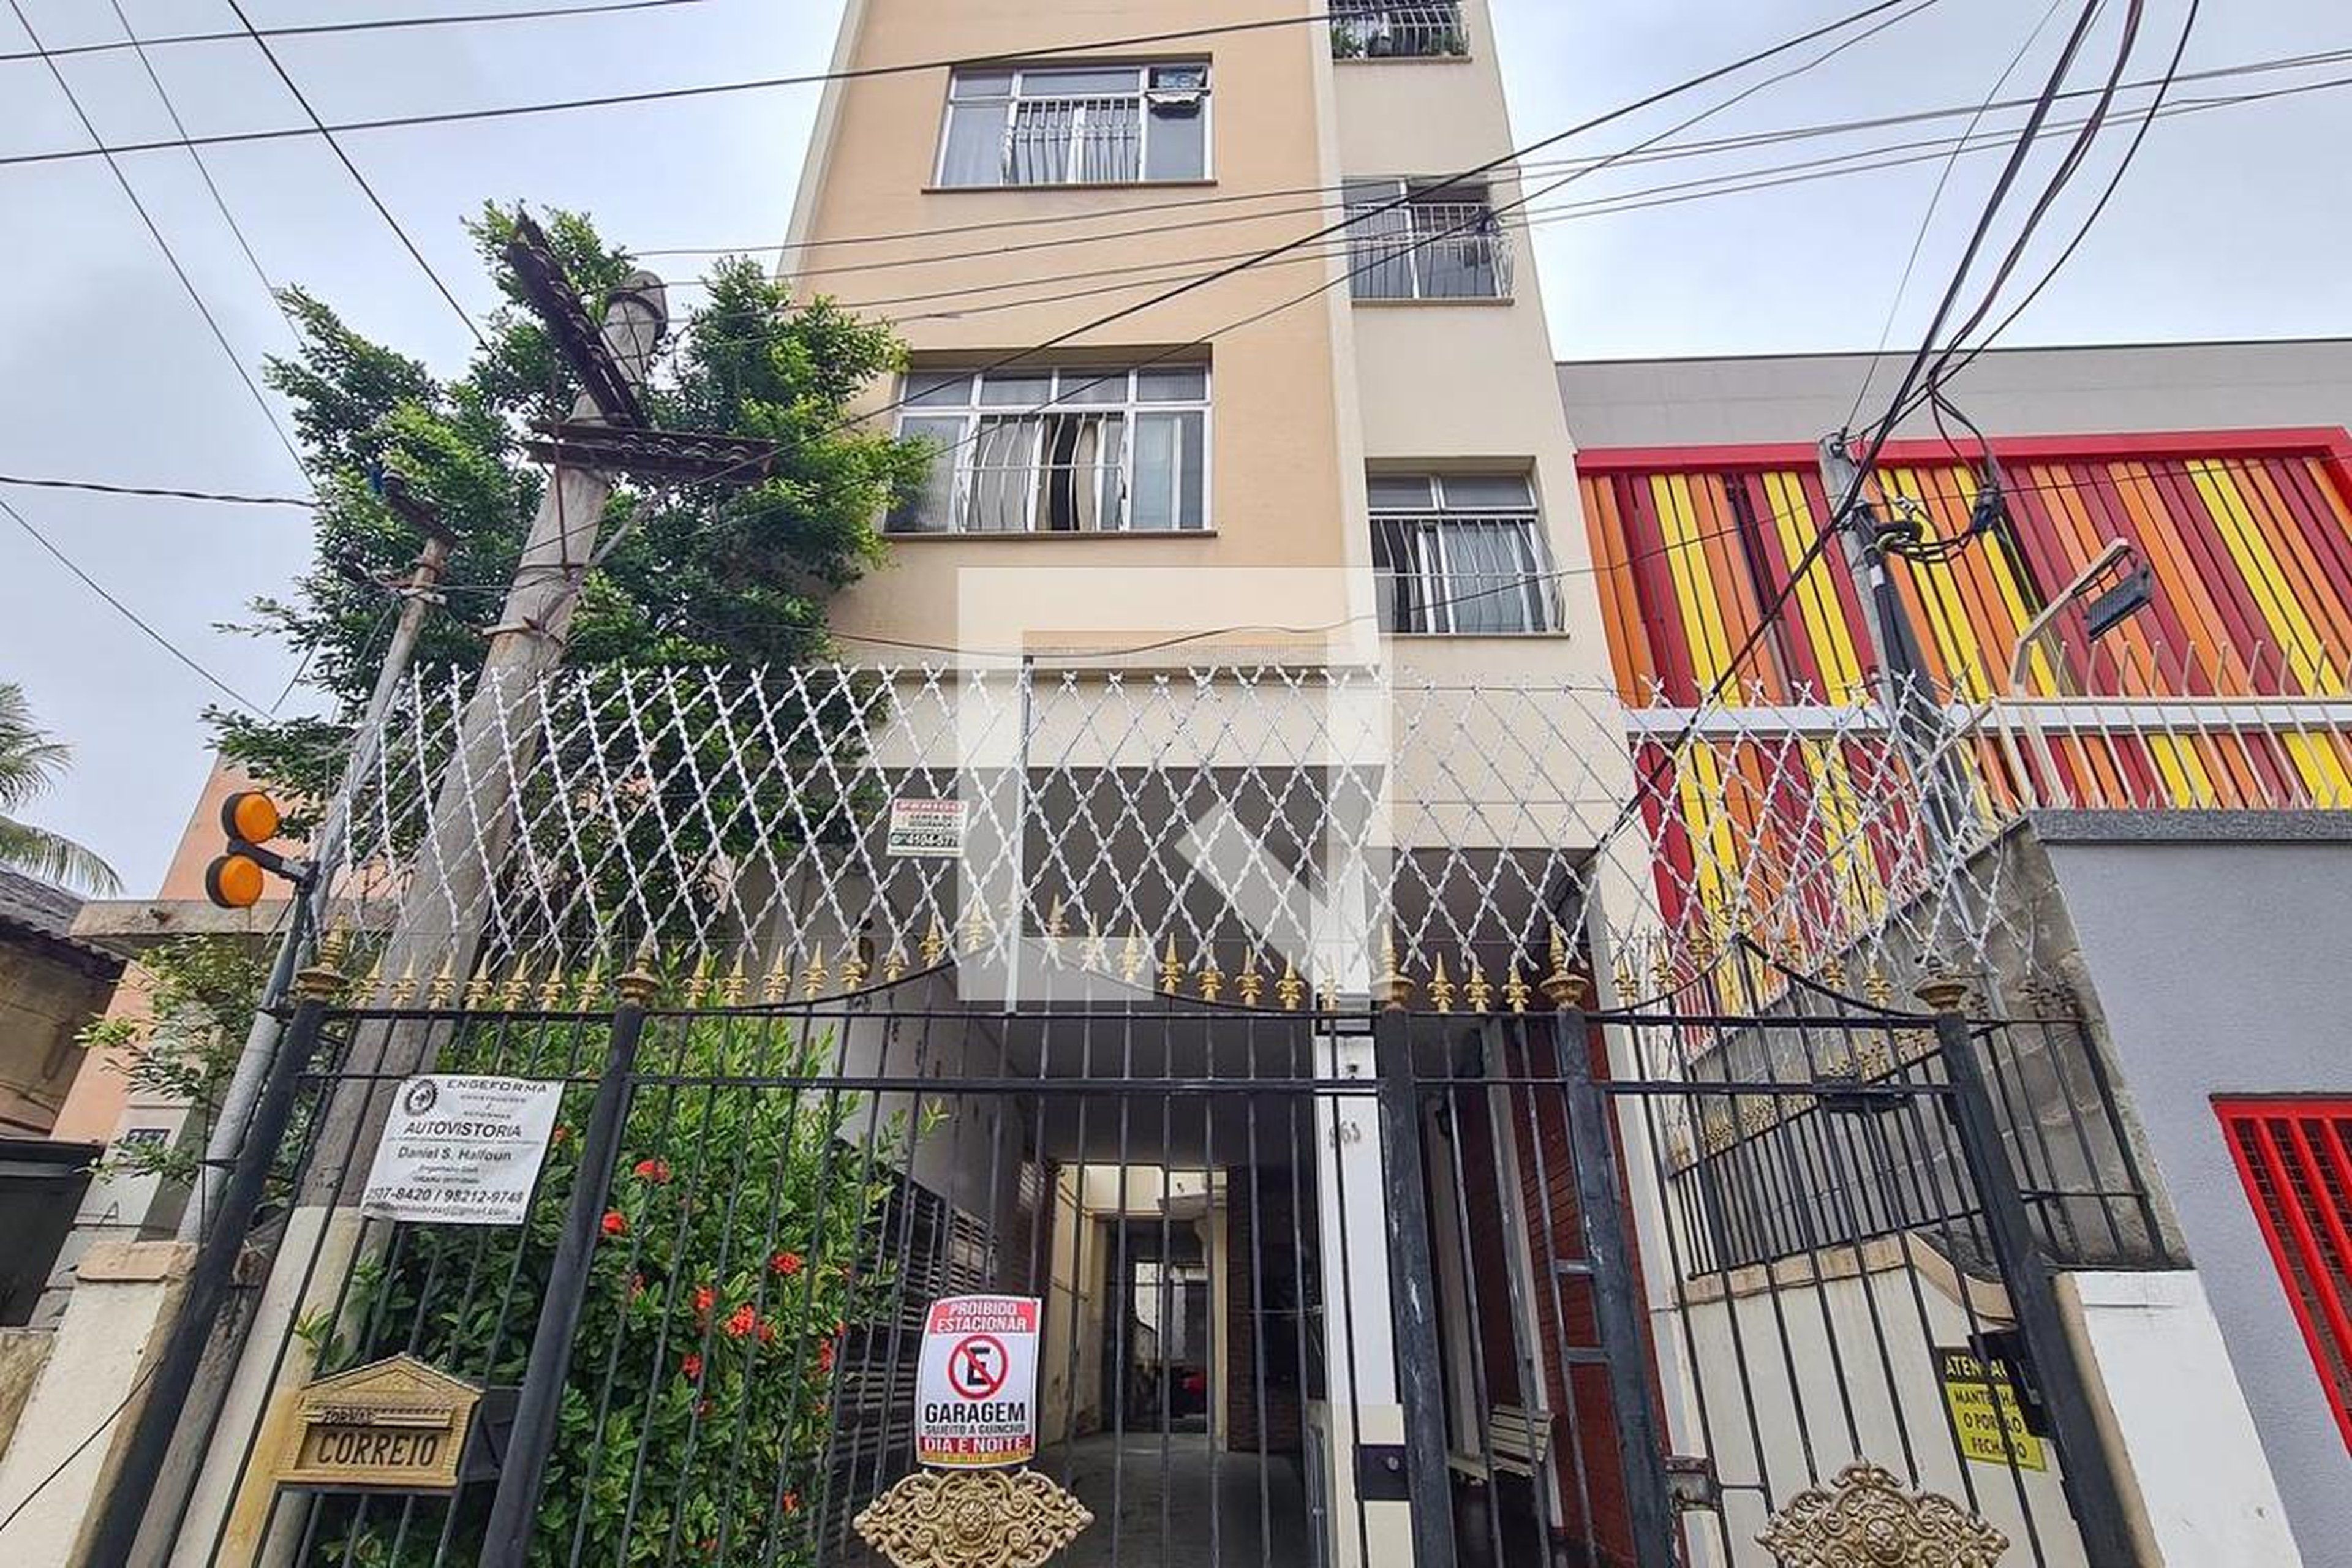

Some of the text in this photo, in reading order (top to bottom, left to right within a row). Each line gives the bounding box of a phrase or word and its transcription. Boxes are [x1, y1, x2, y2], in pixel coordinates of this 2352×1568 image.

[446, 1079, 548, 1094] ENGEFORMA
[404, 1121, 522, 1138] AUTOVISTORIA
[398, 1146, 439, 1159] Daniel
[948, 1302, 1017, 1316] PROIBIDO
[937, 1316, 1027, 1332] ESTACIONAR
[925, 1402, 1025, 1423] GARAGEM
[1963, 1412, 1973, 1428] O
[925, 1424, 1026, 1435] SUJEITO A GUINCHO
[317, 1431, 440, 1468] CORREIO
[924, 1437, 1026, 1453] DIA E NOITE
[1972, 1436, 2028, 1459] FECHO
